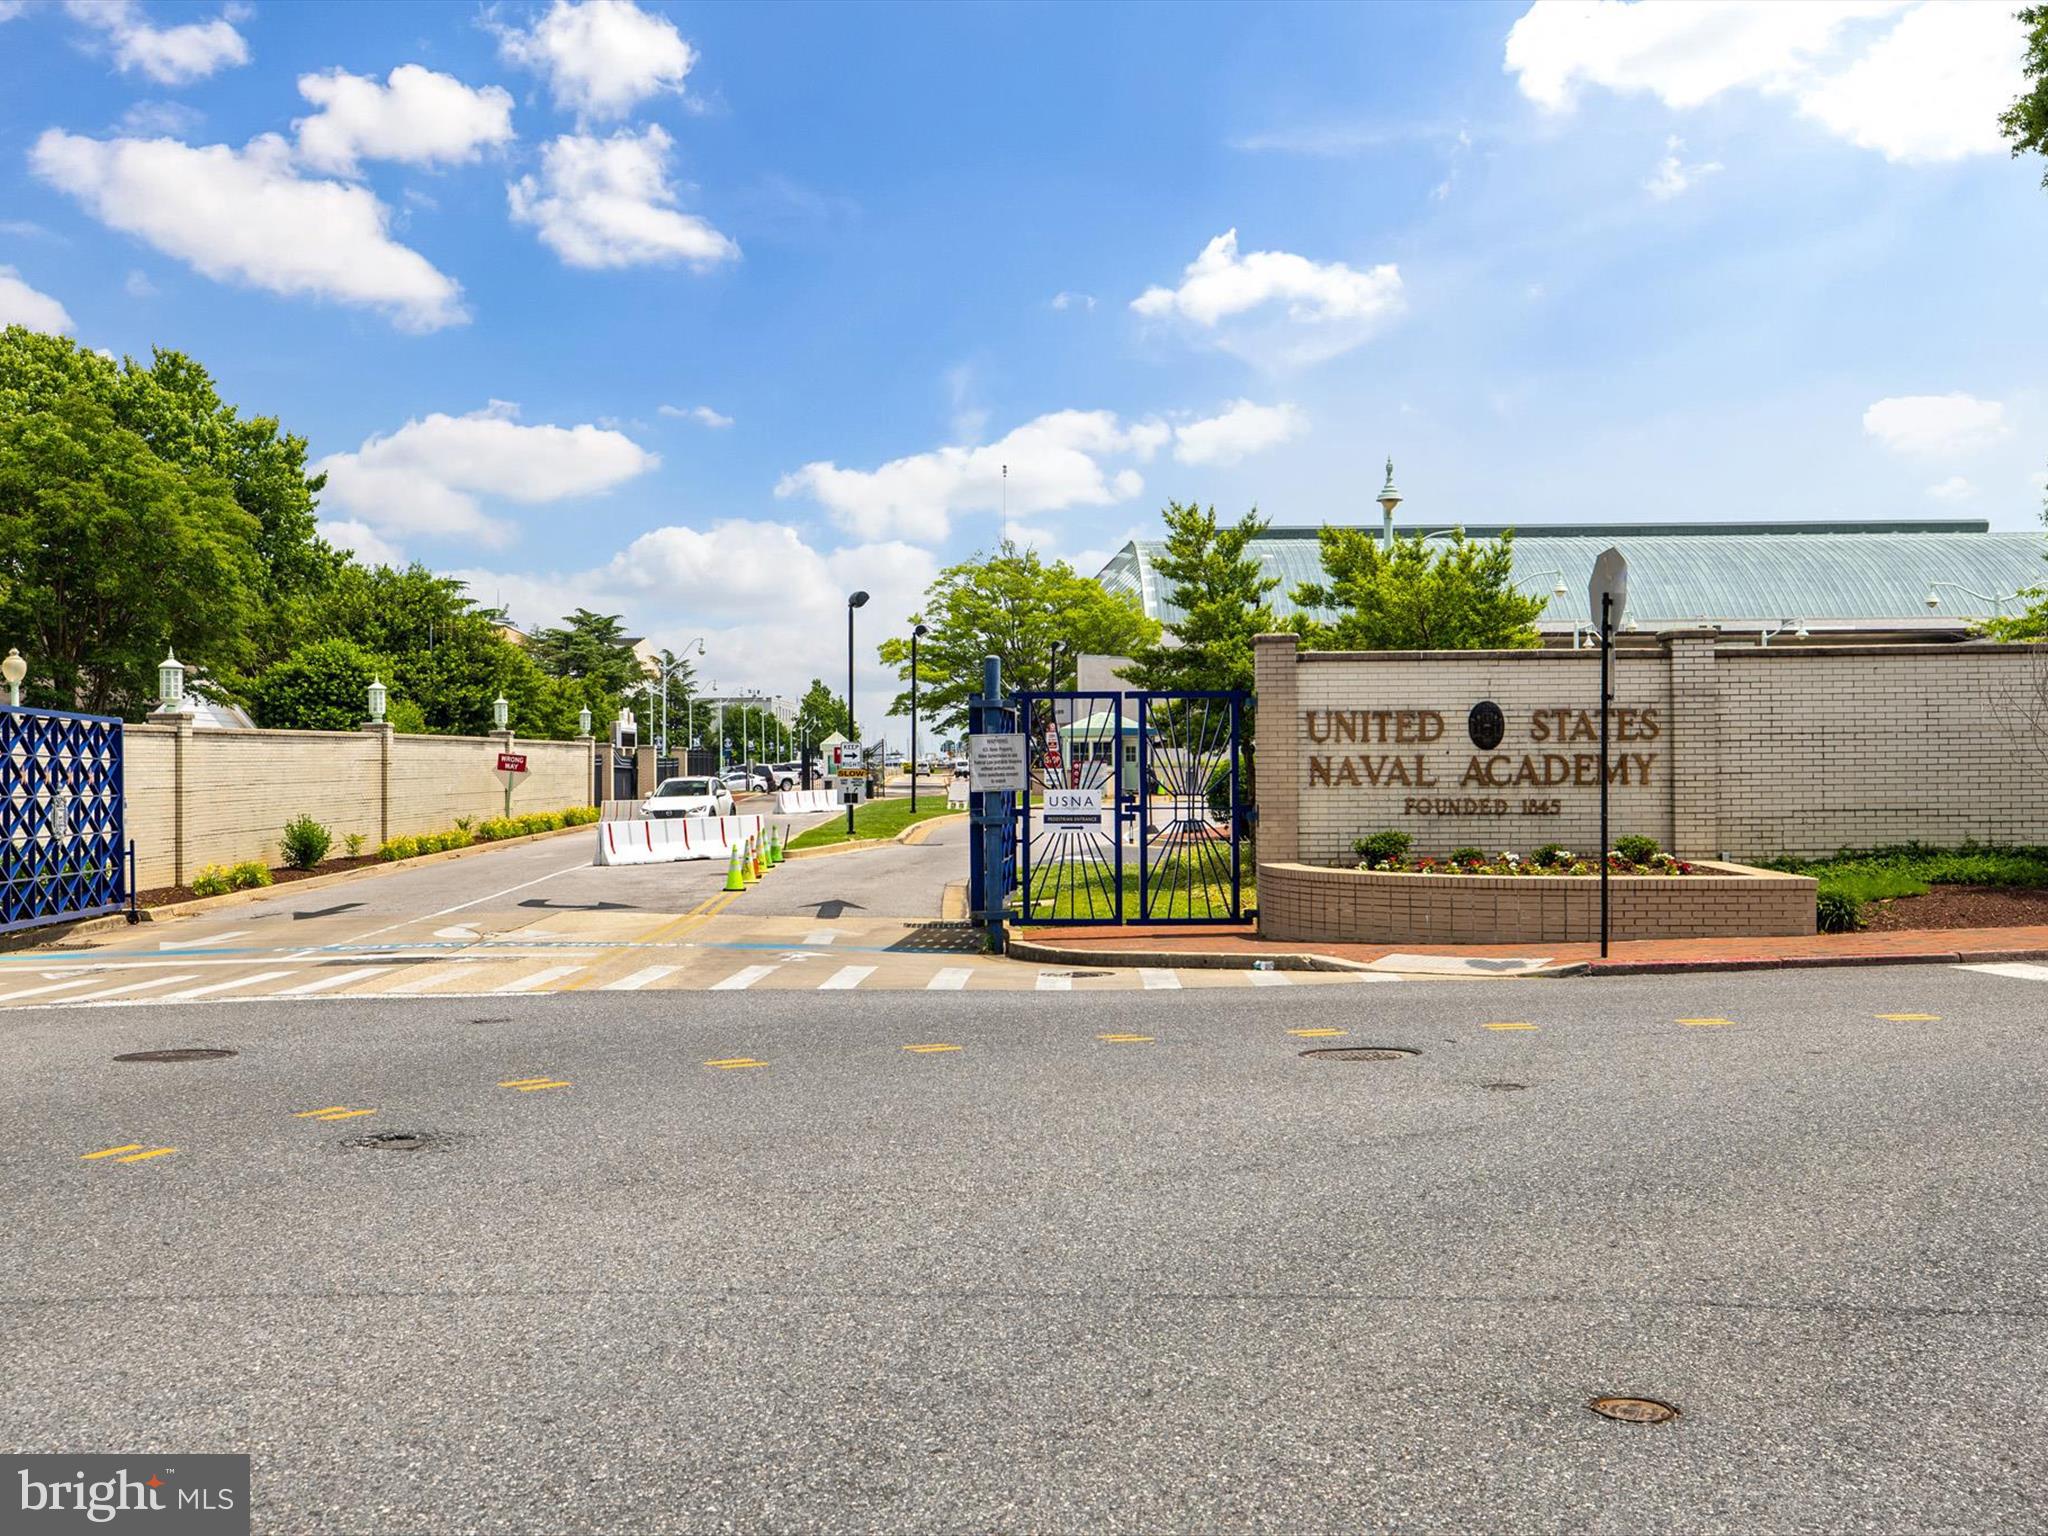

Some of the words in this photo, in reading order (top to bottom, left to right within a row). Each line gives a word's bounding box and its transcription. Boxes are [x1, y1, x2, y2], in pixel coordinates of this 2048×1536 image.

[1307, 710, 1445, 743] UNITED
[501, 756, 524, 764] WRONG
[1308, 755, 1437, 787] NAVAL
[1460, 753, 1658, 787] ACADEMY
[1049, 796, 1094, 807] USNA
[1404, 798, 1508, 816] FOUNDED
[1520, 798, 1562, 816] 1845
